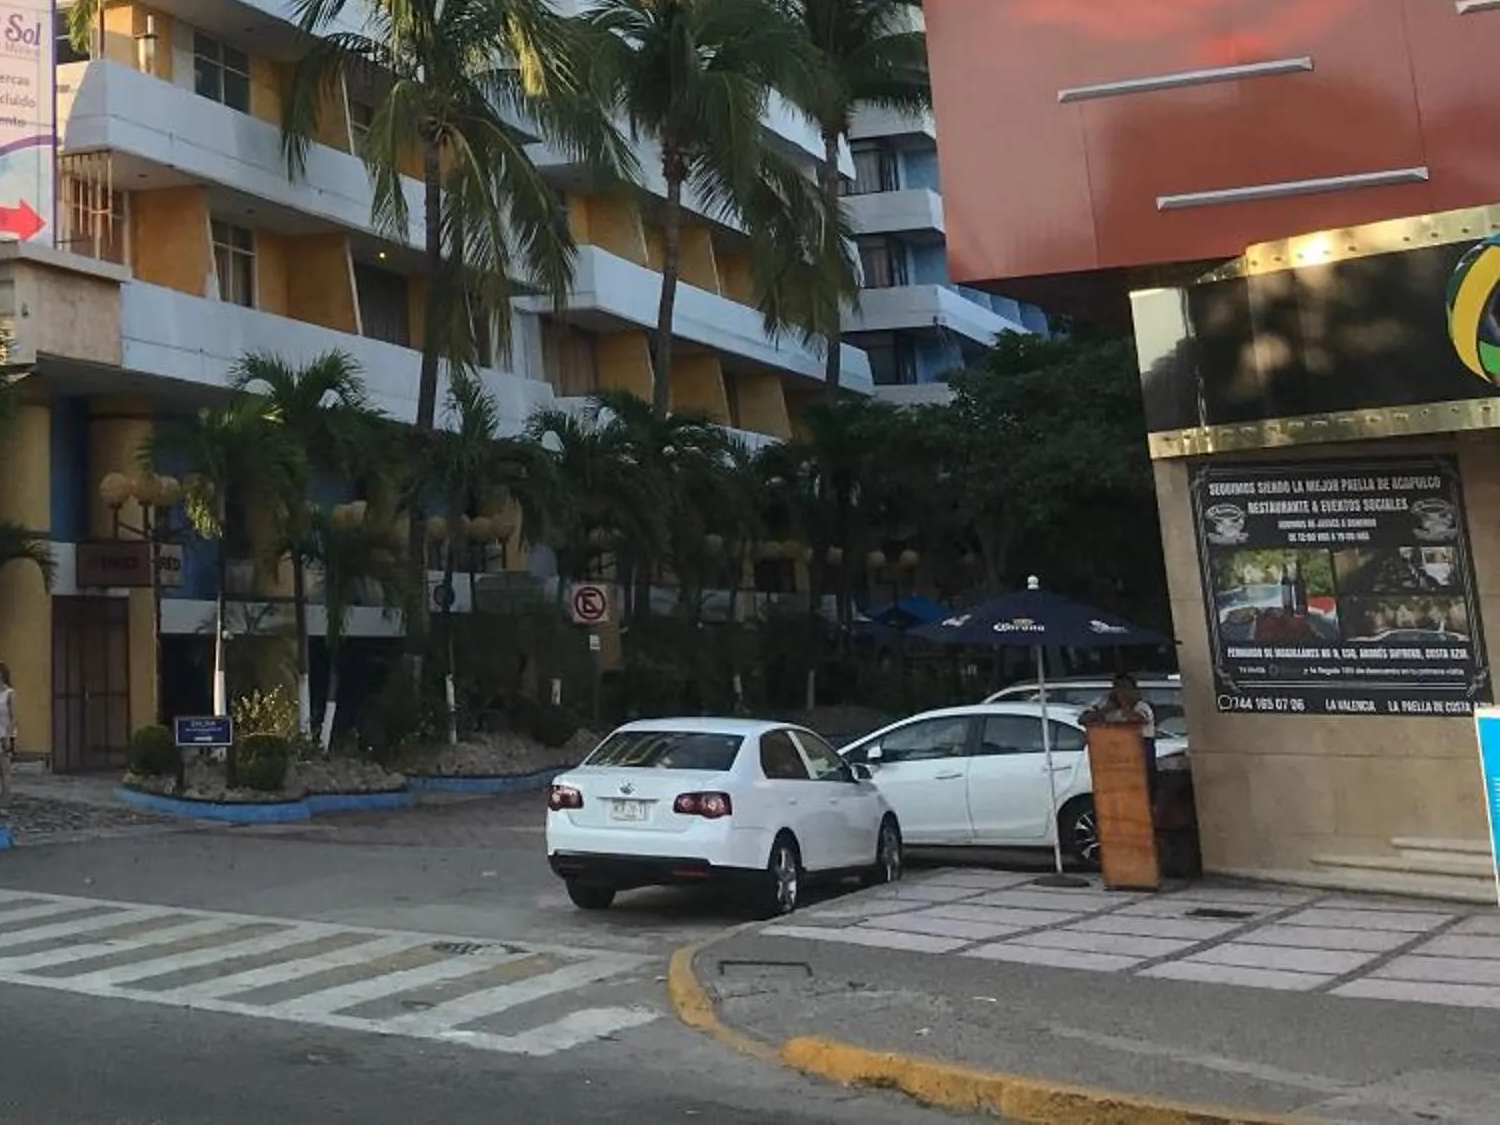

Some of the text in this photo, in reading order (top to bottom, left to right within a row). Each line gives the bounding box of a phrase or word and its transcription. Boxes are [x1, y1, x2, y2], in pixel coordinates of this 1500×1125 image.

[5, 13, 41, 46] Sol
[1306, 478, 1339, 492] MEJOR
[1376, 477, 1391, 490] DE
[1247, 500, 1310, 514] RESTAURANTE
[1362, 498, 1409, 512] SOCIALES
[993, 623, 1045, 631] Corona
[1387, 700, 1399, 712] LA
